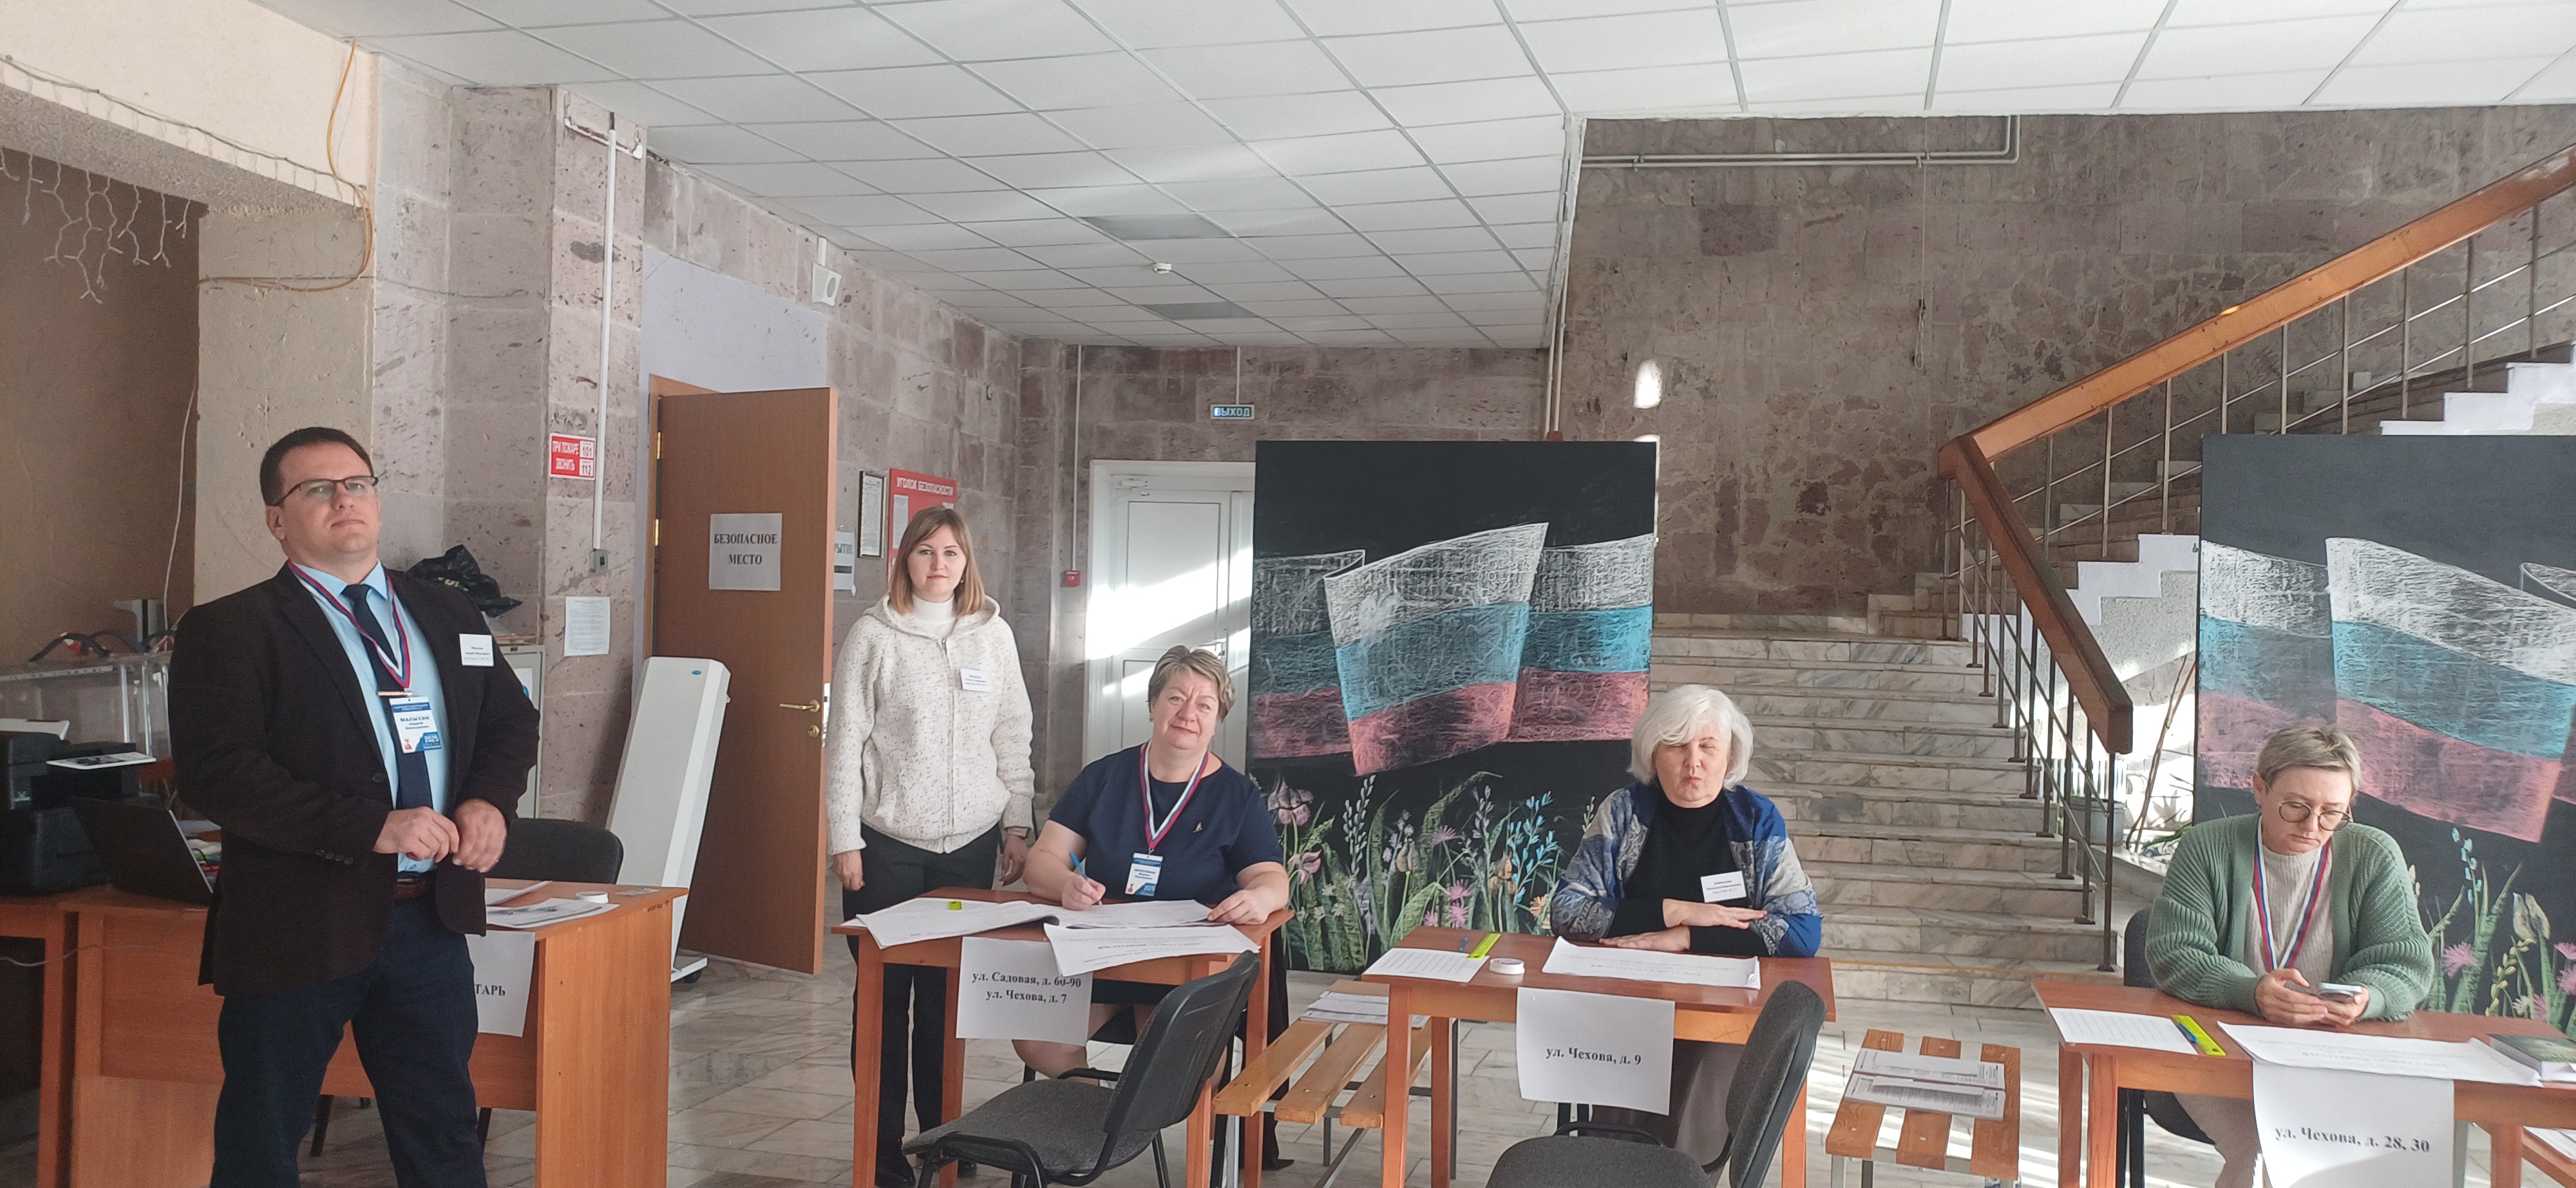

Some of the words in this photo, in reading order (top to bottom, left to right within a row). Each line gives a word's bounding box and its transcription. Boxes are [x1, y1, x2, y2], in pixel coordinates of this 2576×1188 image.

[1214, 407, 1251, 417] ВЫХОД
[582, 446, 592, 457] 101
[582, 465, 592, 475] 112
[714, 533, 778, 544] БЕЗОПАСНОЕ
[728, 553, 763, 565] МЕСТО
[972, 973, 989, 983] ул.
[991, 972, 1040, 986] Садовая,
[1042, 977, 1052, 986] д.
[1054, 975, 1081, 988] 60-90
[475, 984, 506, 996] ТАРЬ
[985, 991, 1003, 1001] ул.
[1006, 990, 1046, 1004] Чехова,
[1048, 995, 1059, 1004] д.
[1061, 993, 1067, 1004] 7
[1546, 1048, 1565, 1060] ул.
[1569, 1047, 1617, 1065] Чехова,
[1619, 1055, 1631, 1065] д.
[1634, 1054, 1642, 1066] 9
[2275, 1128, 2297, 1141] ул.
[2300, 1127, 2362, 1147] Чехова,
[2365, 1136, 2379, 1147] д.
[2384, 1135, 2407, 1153] 28,
[2410, 1138, 2430, 1153] 30
